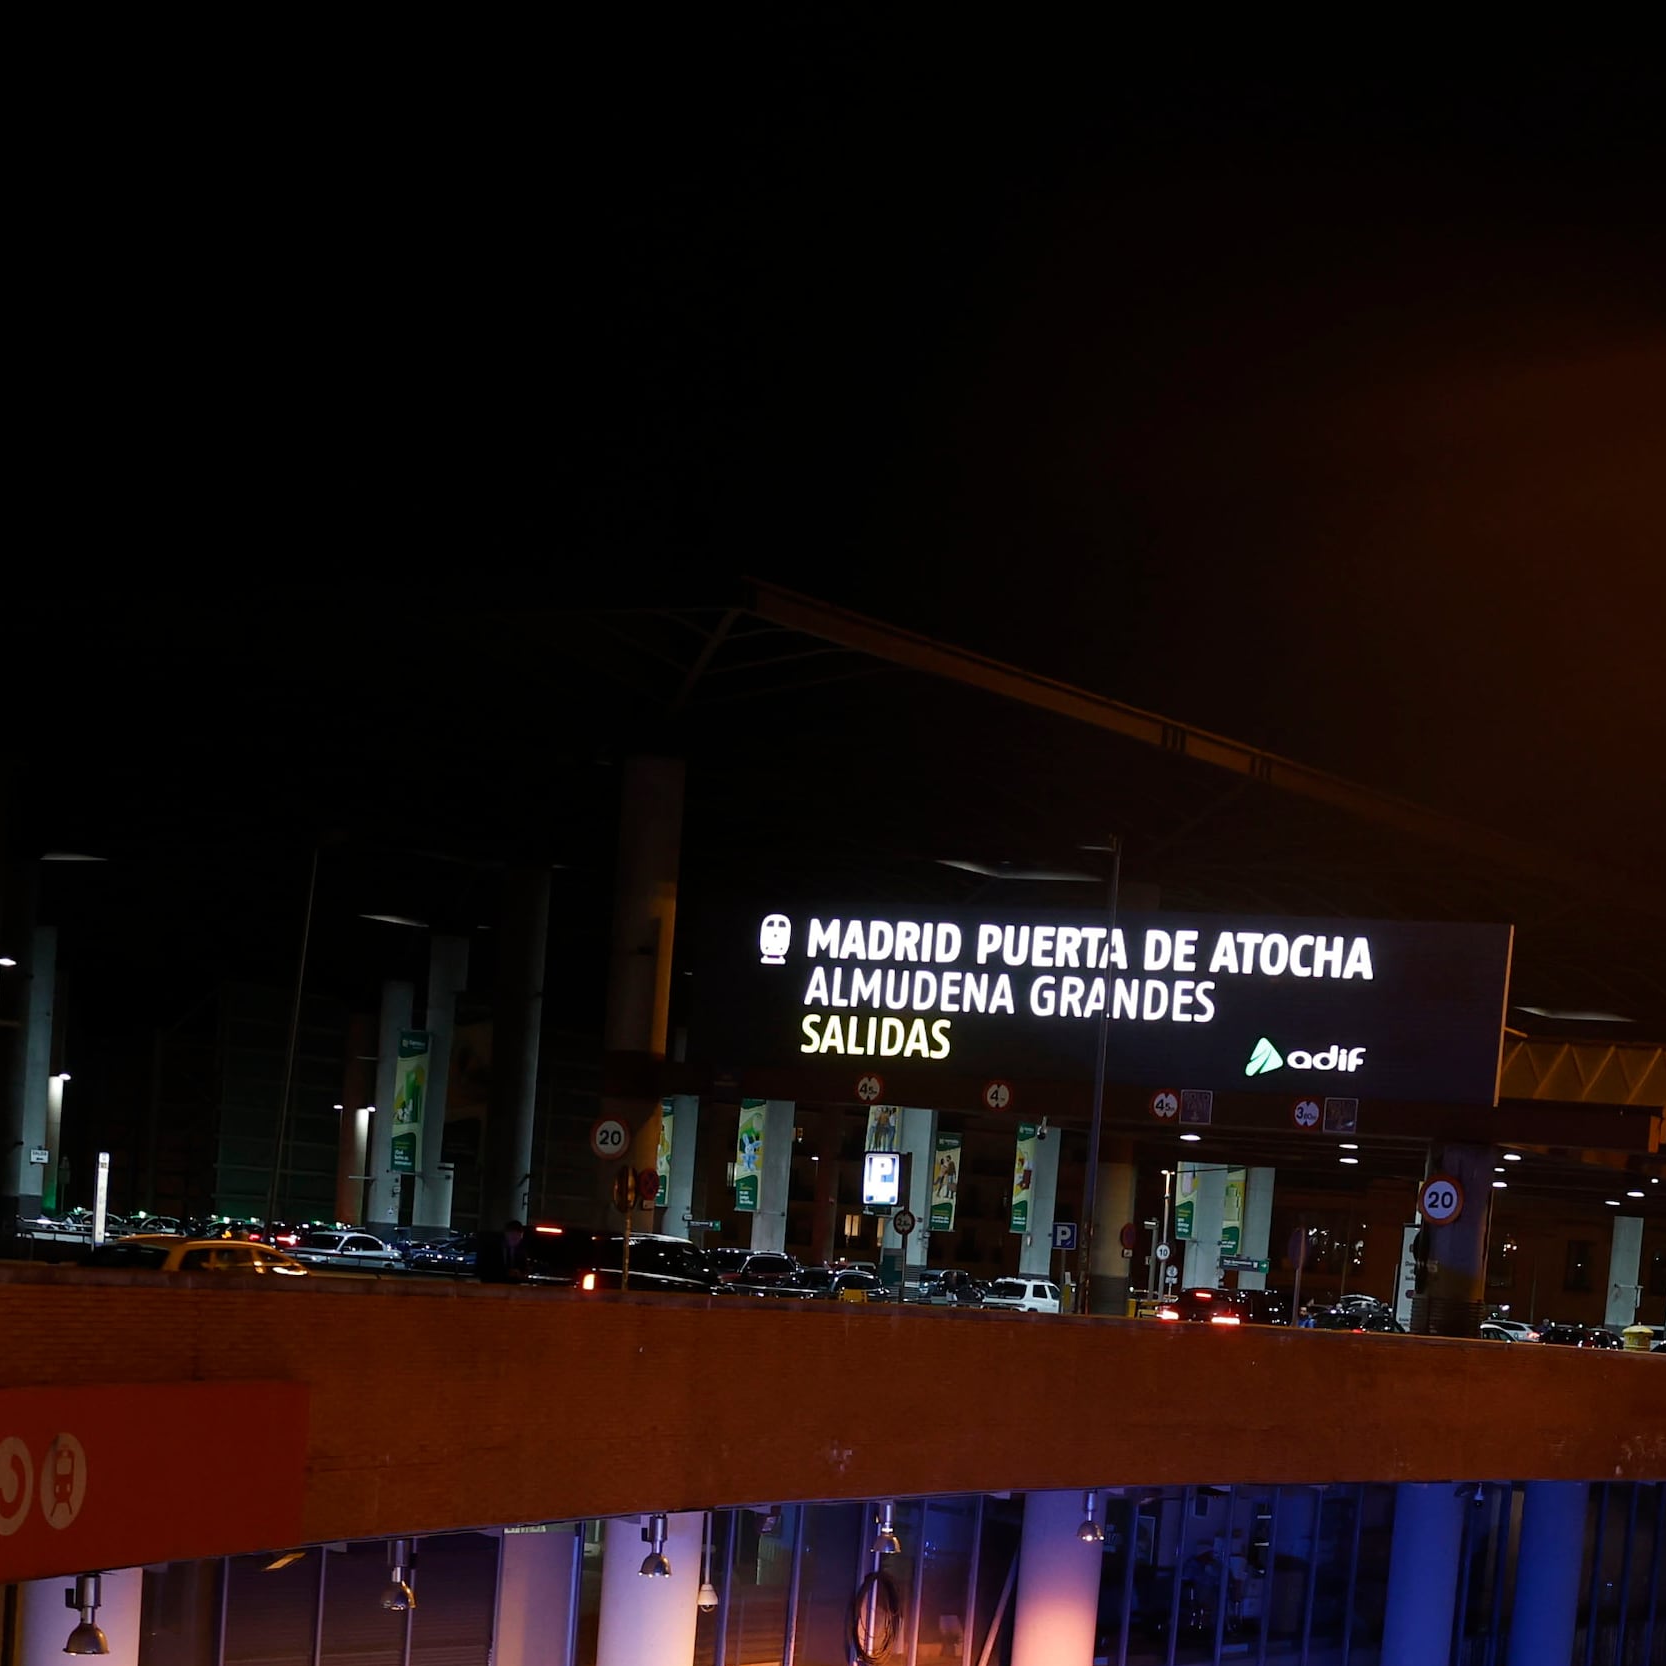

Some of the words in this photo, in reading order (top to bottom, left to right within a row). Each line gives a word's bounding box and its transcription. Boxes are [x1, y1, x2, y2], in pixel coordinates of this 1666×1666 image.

[807, 917, 962, 963] MADRID
[976, 923, 1130, 971] PUERTA
[1143, 928, 1200, 973] DE
[1209, 931, 1375, 981] ATOCHA
[804, 966, 1015, 1015] ALMUDENA
[1030, 974, 1216, 1023] GRANDES
[800, 1014, 952, 1060] SALIDAS
[1286, 1045, 1366, 1074] adif
[599, 1130, 622, 1146] 20
[1428, 1190, 1454, 1209] 20
[1061, 1225, 1072, 1241] P
